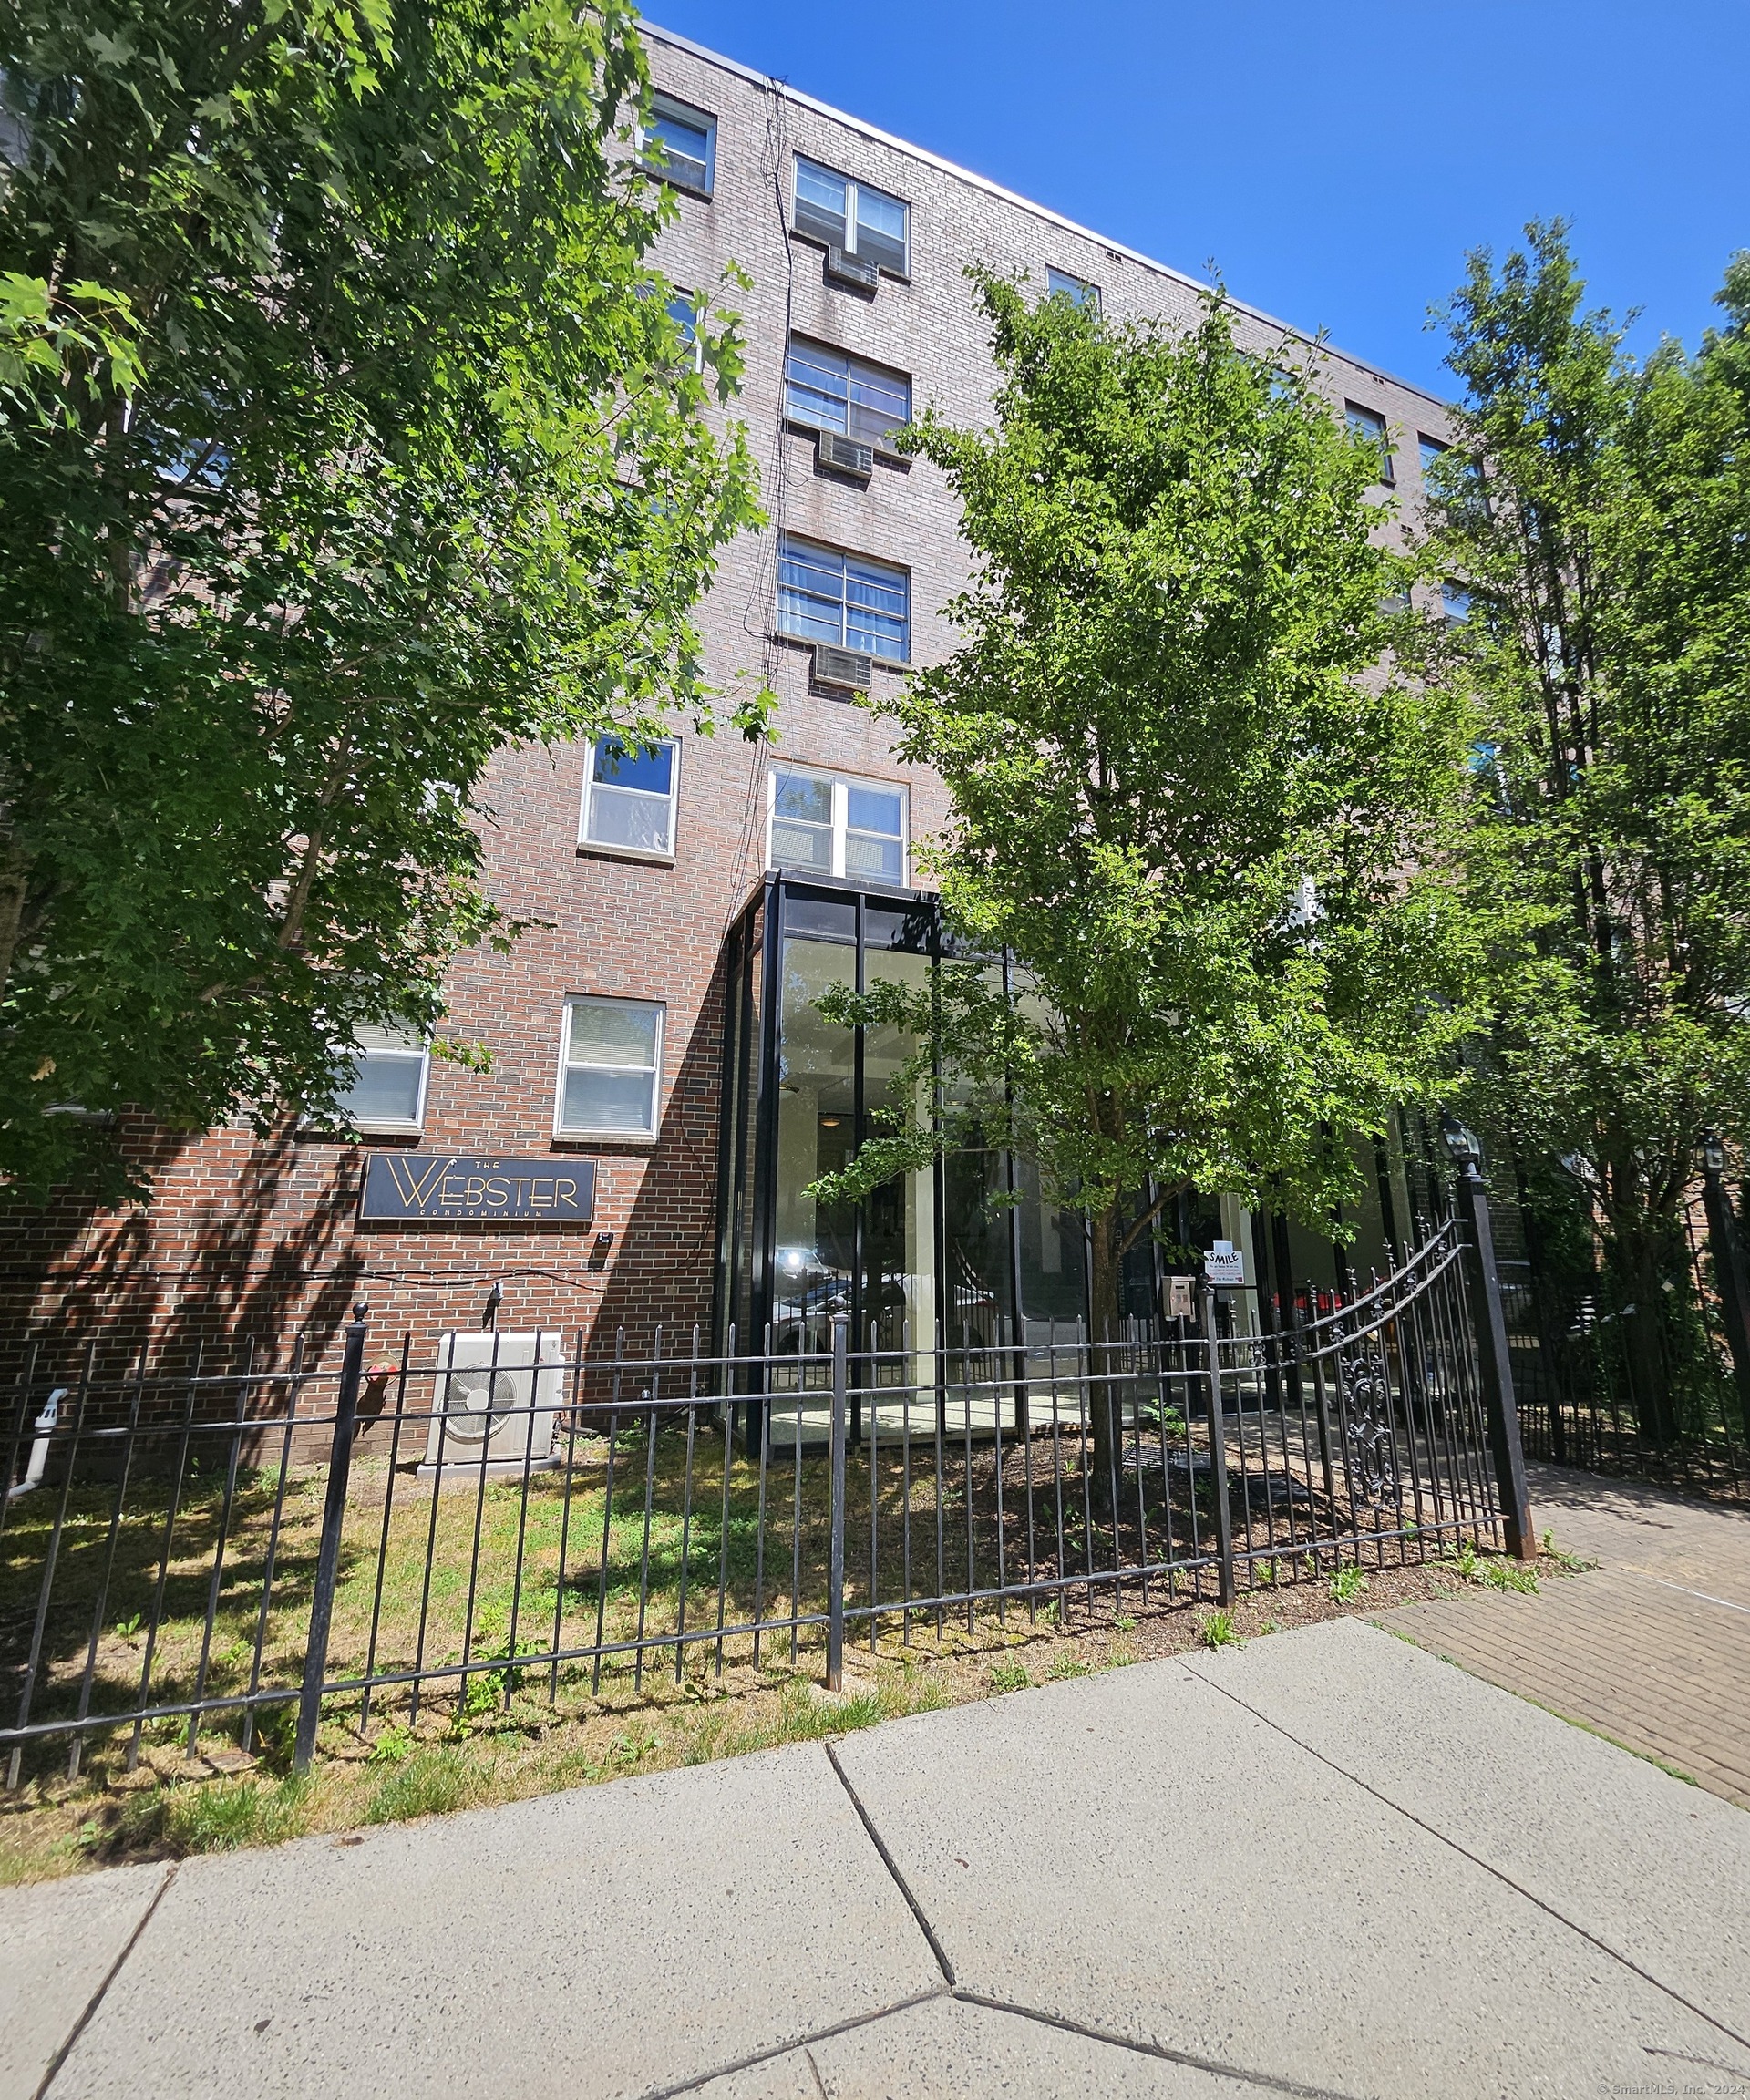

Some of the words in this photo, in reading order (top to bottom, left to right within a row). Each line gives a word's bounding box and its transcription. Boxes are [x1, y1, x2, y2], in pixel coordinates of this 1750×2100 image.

[475, 1161, 500, 1169] THE
[386, 1158, 579, 1208] WEBSTER
[419, 1209, 542, 1218] CONDOMINIUM
[1209, 1252, 1239, 1264] SMILE
